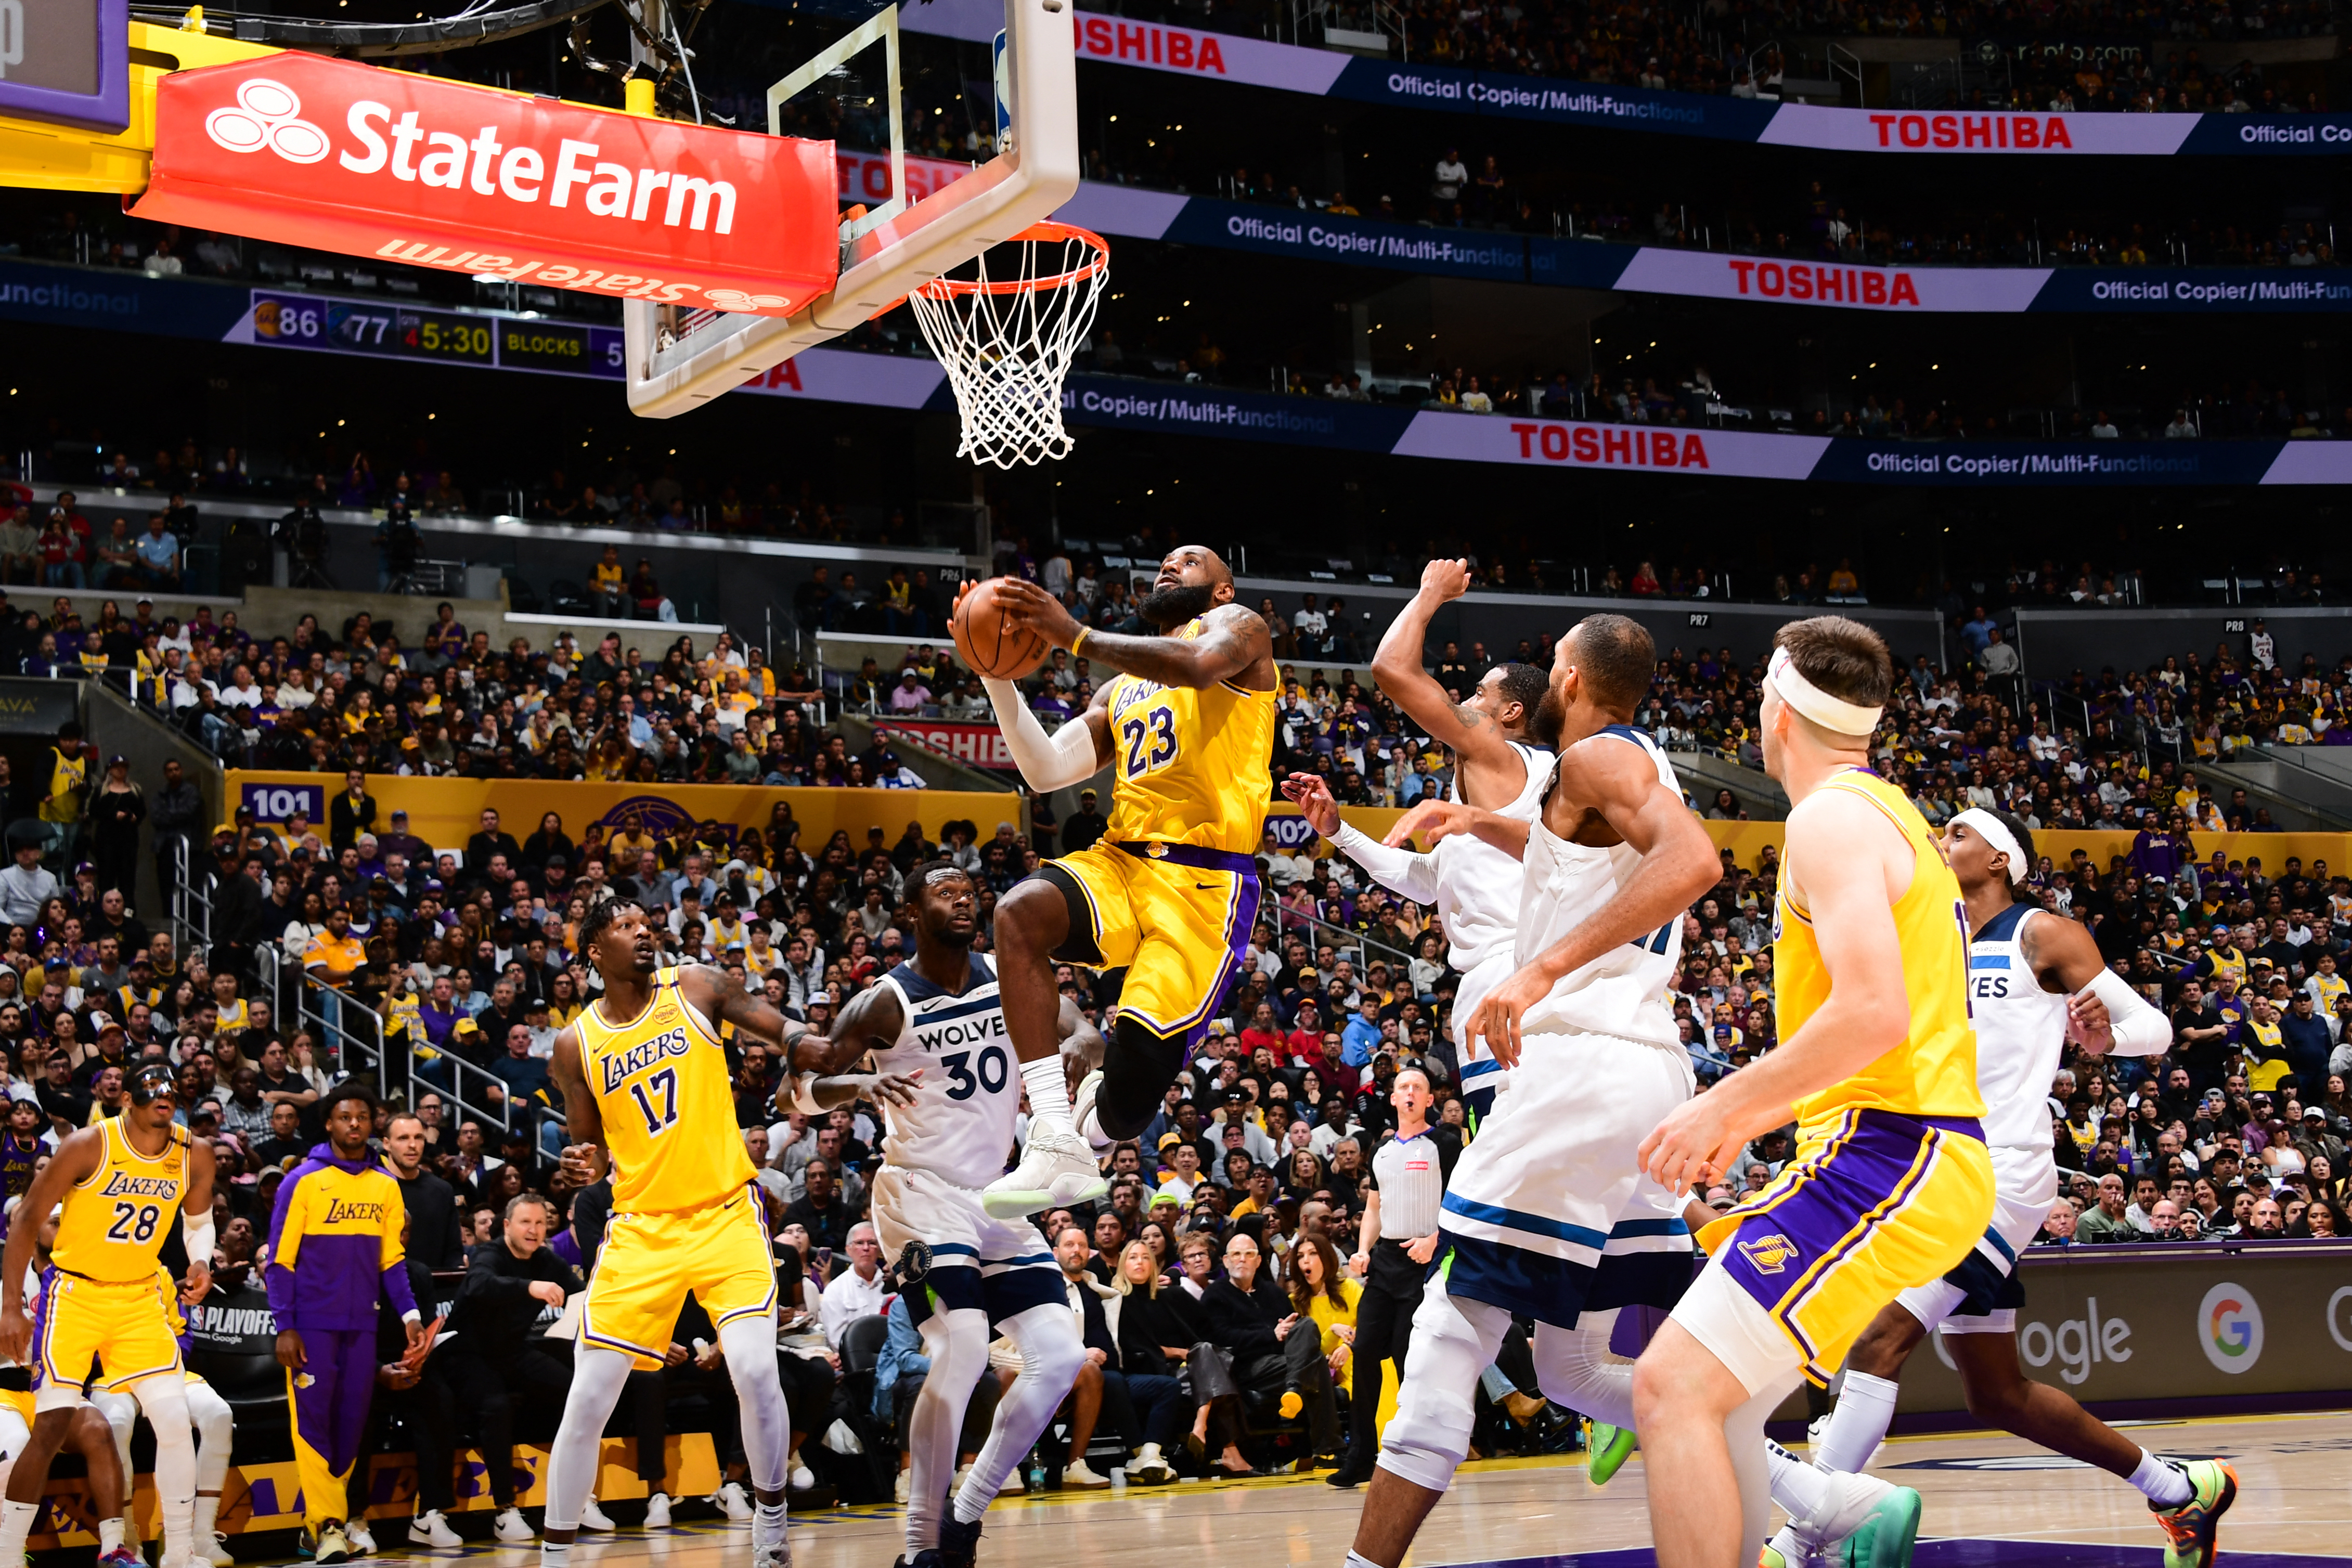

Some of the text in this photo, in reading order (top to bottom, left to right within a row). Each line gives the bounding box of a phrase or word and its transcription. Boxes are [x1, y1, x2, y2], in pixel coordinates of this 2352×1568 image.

[1075, 19, 1226, 74] SHIBA
[1388, 74, 1461, 99] Official
[1870, 114, 2072, 148] TOSHIBA
[2241, 125, 2315, 144] Official
[1228, 216, 1301, 243] Official
[1728, 260, 1920, 306] TOSHIBA
[2092, 281, 2169, 299] Official
[279, 309, 318, 337] 86
[351, 315, 390, 345] 77
[405, 329, 418, 347] 4
[422, 322, 489, 355] 5:30
[508, 333, 580, 357] BLOCKS
[608, 342, 622, 367] 5
[1511, 423, 1709, 469] TOSHIBA
[1868, 452, 1939, 472] Official
[940, 568, 961, 582] PR6
[1690, 614, 1709, 626] PR7
[2226, 620, 2244, 632] PR8
[1122, 704, 1188, 779] 23
[252, 788, 309, 818] 101
[1269, 819, 1314, 845] 102
[655, 1007, 677, 1020] bibigo
[917, 1014, 1006, 1053] WOLVE
[605, 1027, 694, 1096] LAKERS
[945, 1055, 1009, 1100] 30
[636, 1068, 683, 1139] 17
[100, 1171, 180, 1200] LAKERS
[105, 1201, 160, 1243] 28
[322, 1198, 384, 1224] LAKERS
[212, 1332, 242, 1345] Google
